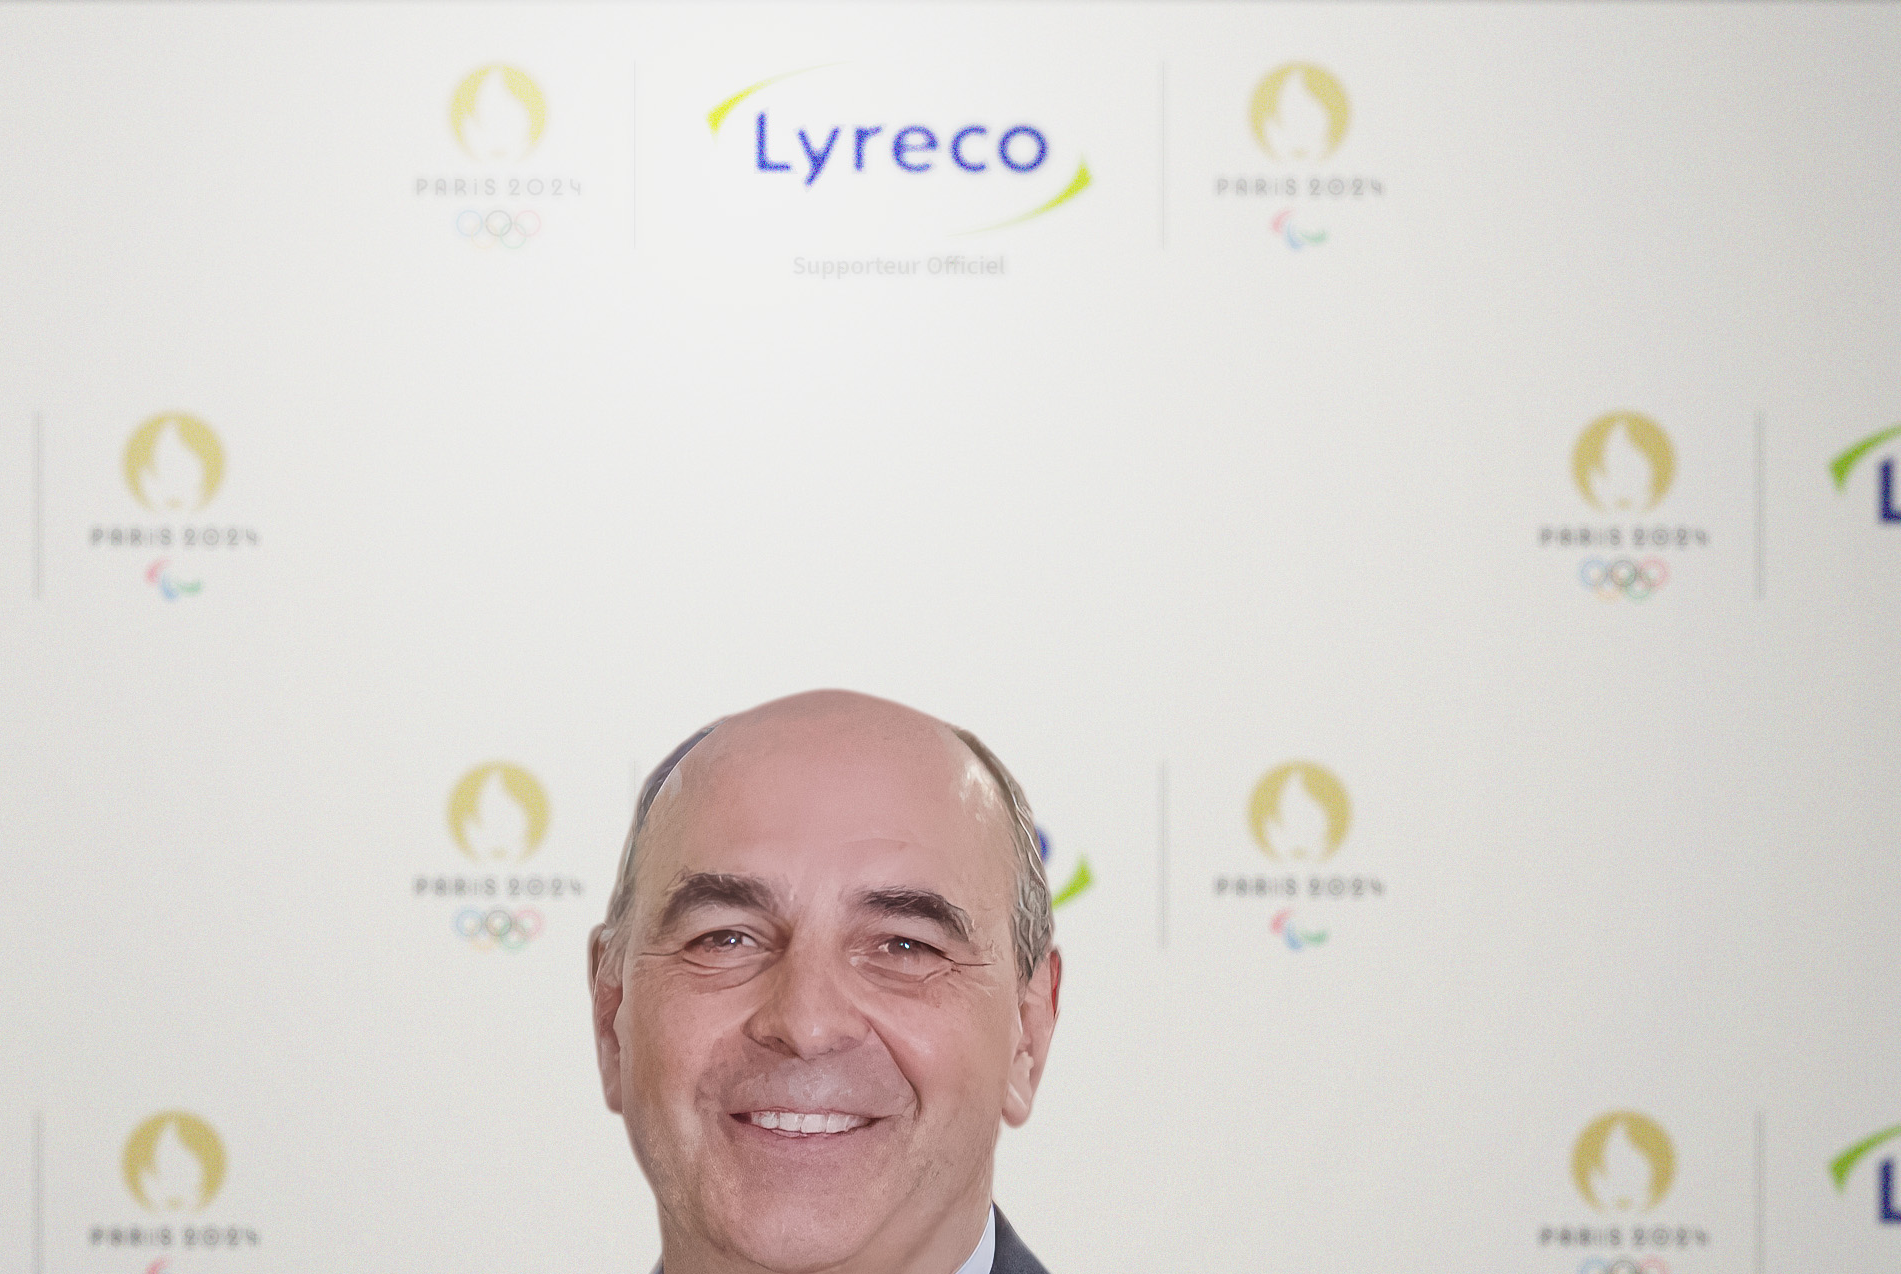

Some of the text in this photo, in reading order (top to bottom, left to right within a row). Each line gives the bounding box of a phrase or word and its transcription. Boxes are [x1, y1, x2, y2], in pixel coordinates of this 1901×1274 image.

[752, 107, 1052, 191] Lyreco
[506, 175, 586, 199] 2024
[1307, 175, 1387, 199] 2024
[182, 525, 262, 549] 2024
[1631, 525, 1711, 549] 2024
[506, 875, 586, 899] 2024
[1307, 875, 1387, 899] 2024
[182, 1225, 262, 1249] 2024
[1631, 1225, 1711, 1249] 2024
